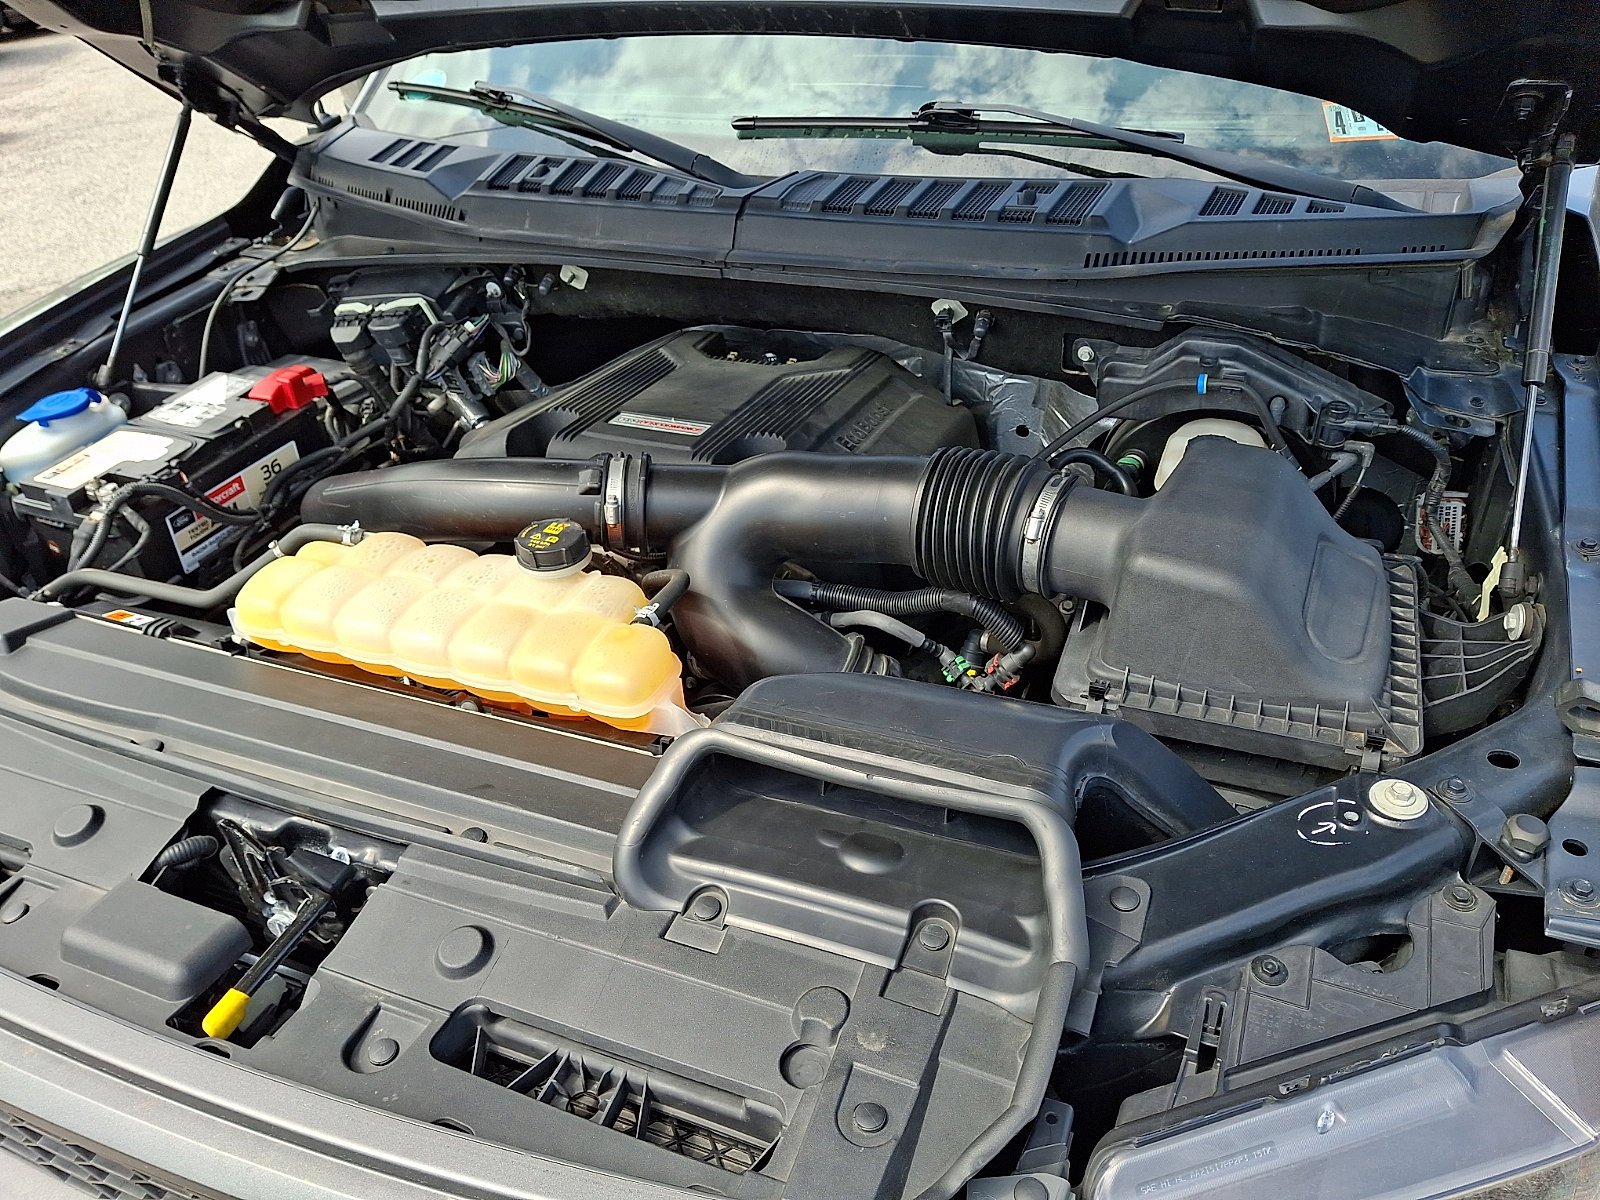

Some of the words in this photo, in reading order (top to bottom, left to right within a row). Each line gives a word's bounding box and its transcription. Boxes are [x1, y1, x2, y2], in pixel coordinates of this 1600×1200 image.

[261, 459, 281, 480] 36
[213, 483, 241, 503] orcraft
[1140, 1184, 1157, 1196] SAE
